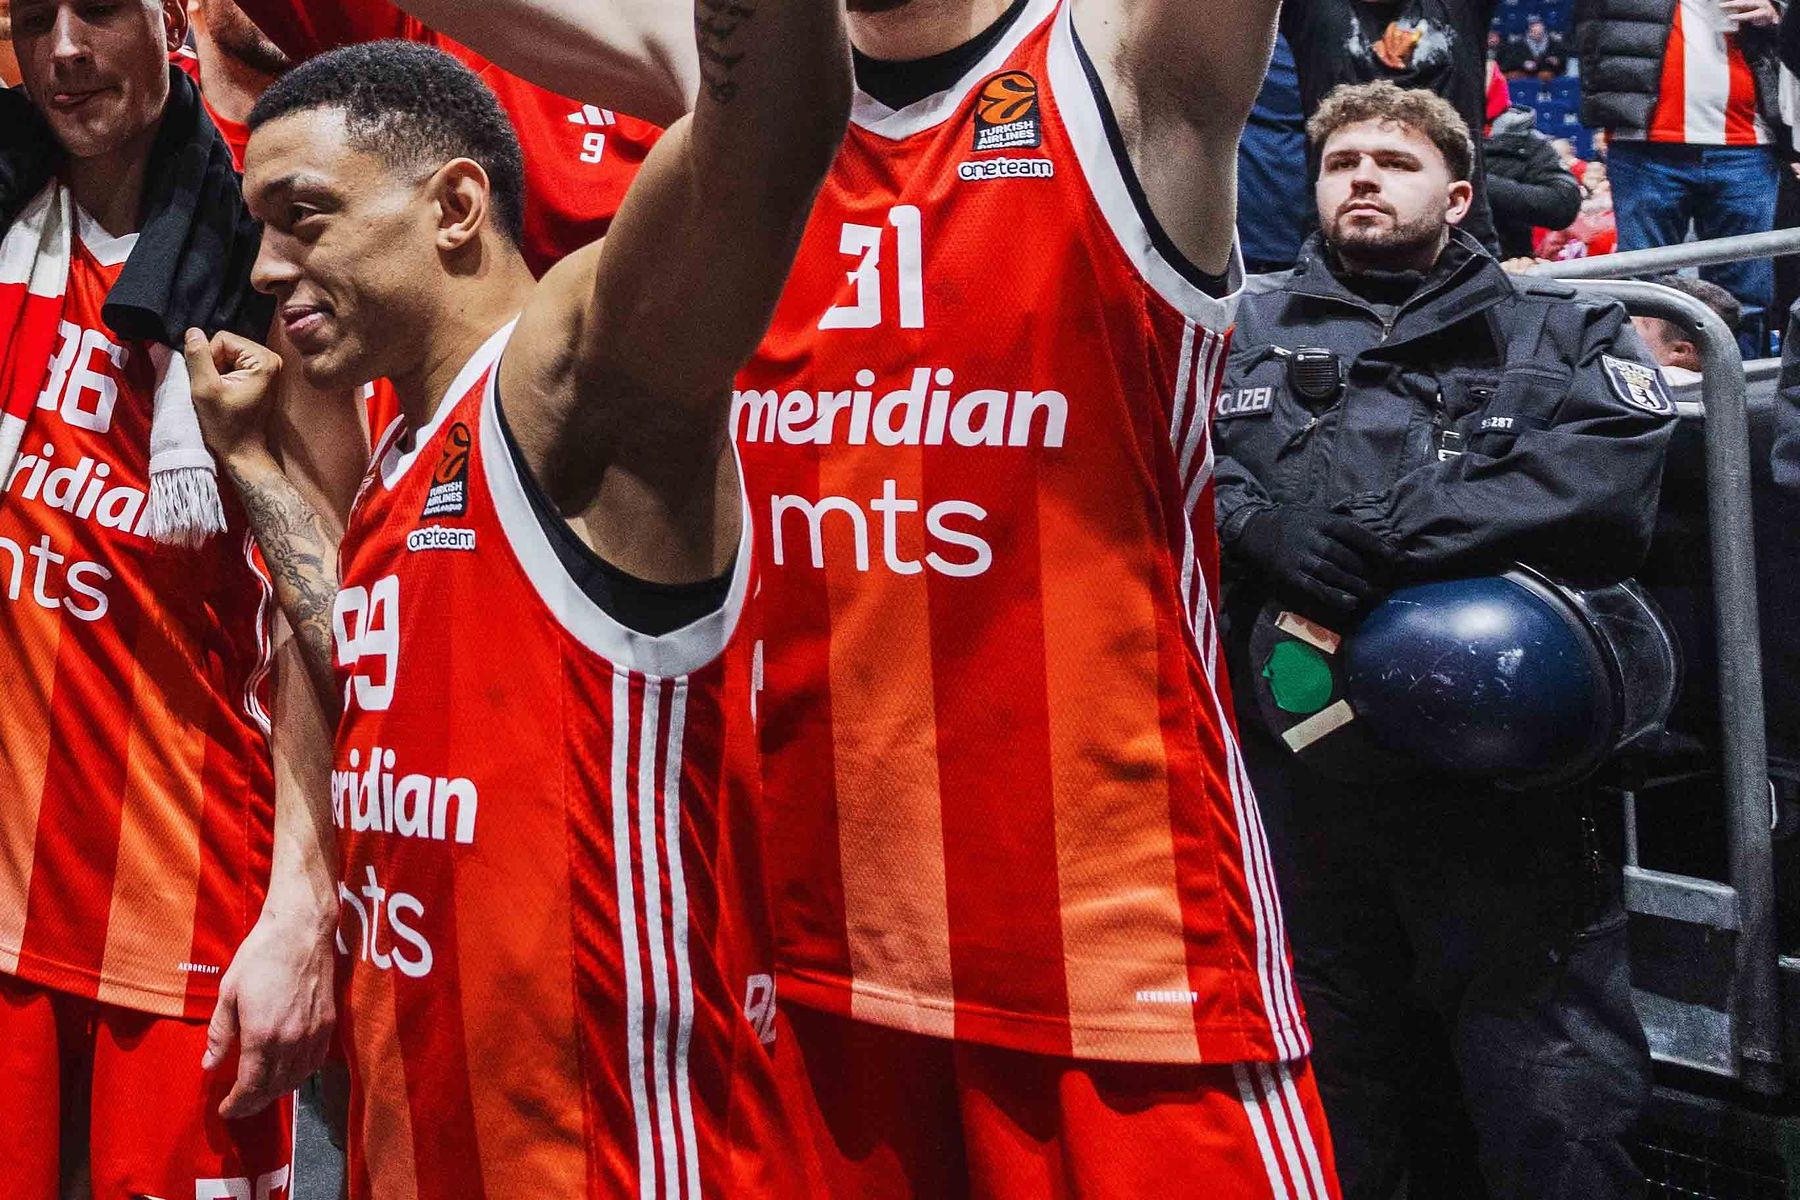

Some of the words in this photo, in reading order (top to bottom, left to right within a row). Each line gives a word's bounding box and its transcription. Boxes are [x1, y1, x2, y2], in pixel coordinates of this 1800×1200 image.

[979, 129, 1035, 145] AIRLINES
[980, 120, 1034, 138] TURKISH
[579, 132, 606, 164] 9
[961, 161, 1051, 177] oneteam
[817, 204, 925, 330] 31
[731, 367, 1069, 448] meridian
[1216, 387, 1272, 415] OLIZEI
[408, 529, 475, 548] oneteam
[771, 478, 993, 578] mts
[178, 962, 220, 974] AEROREADY
